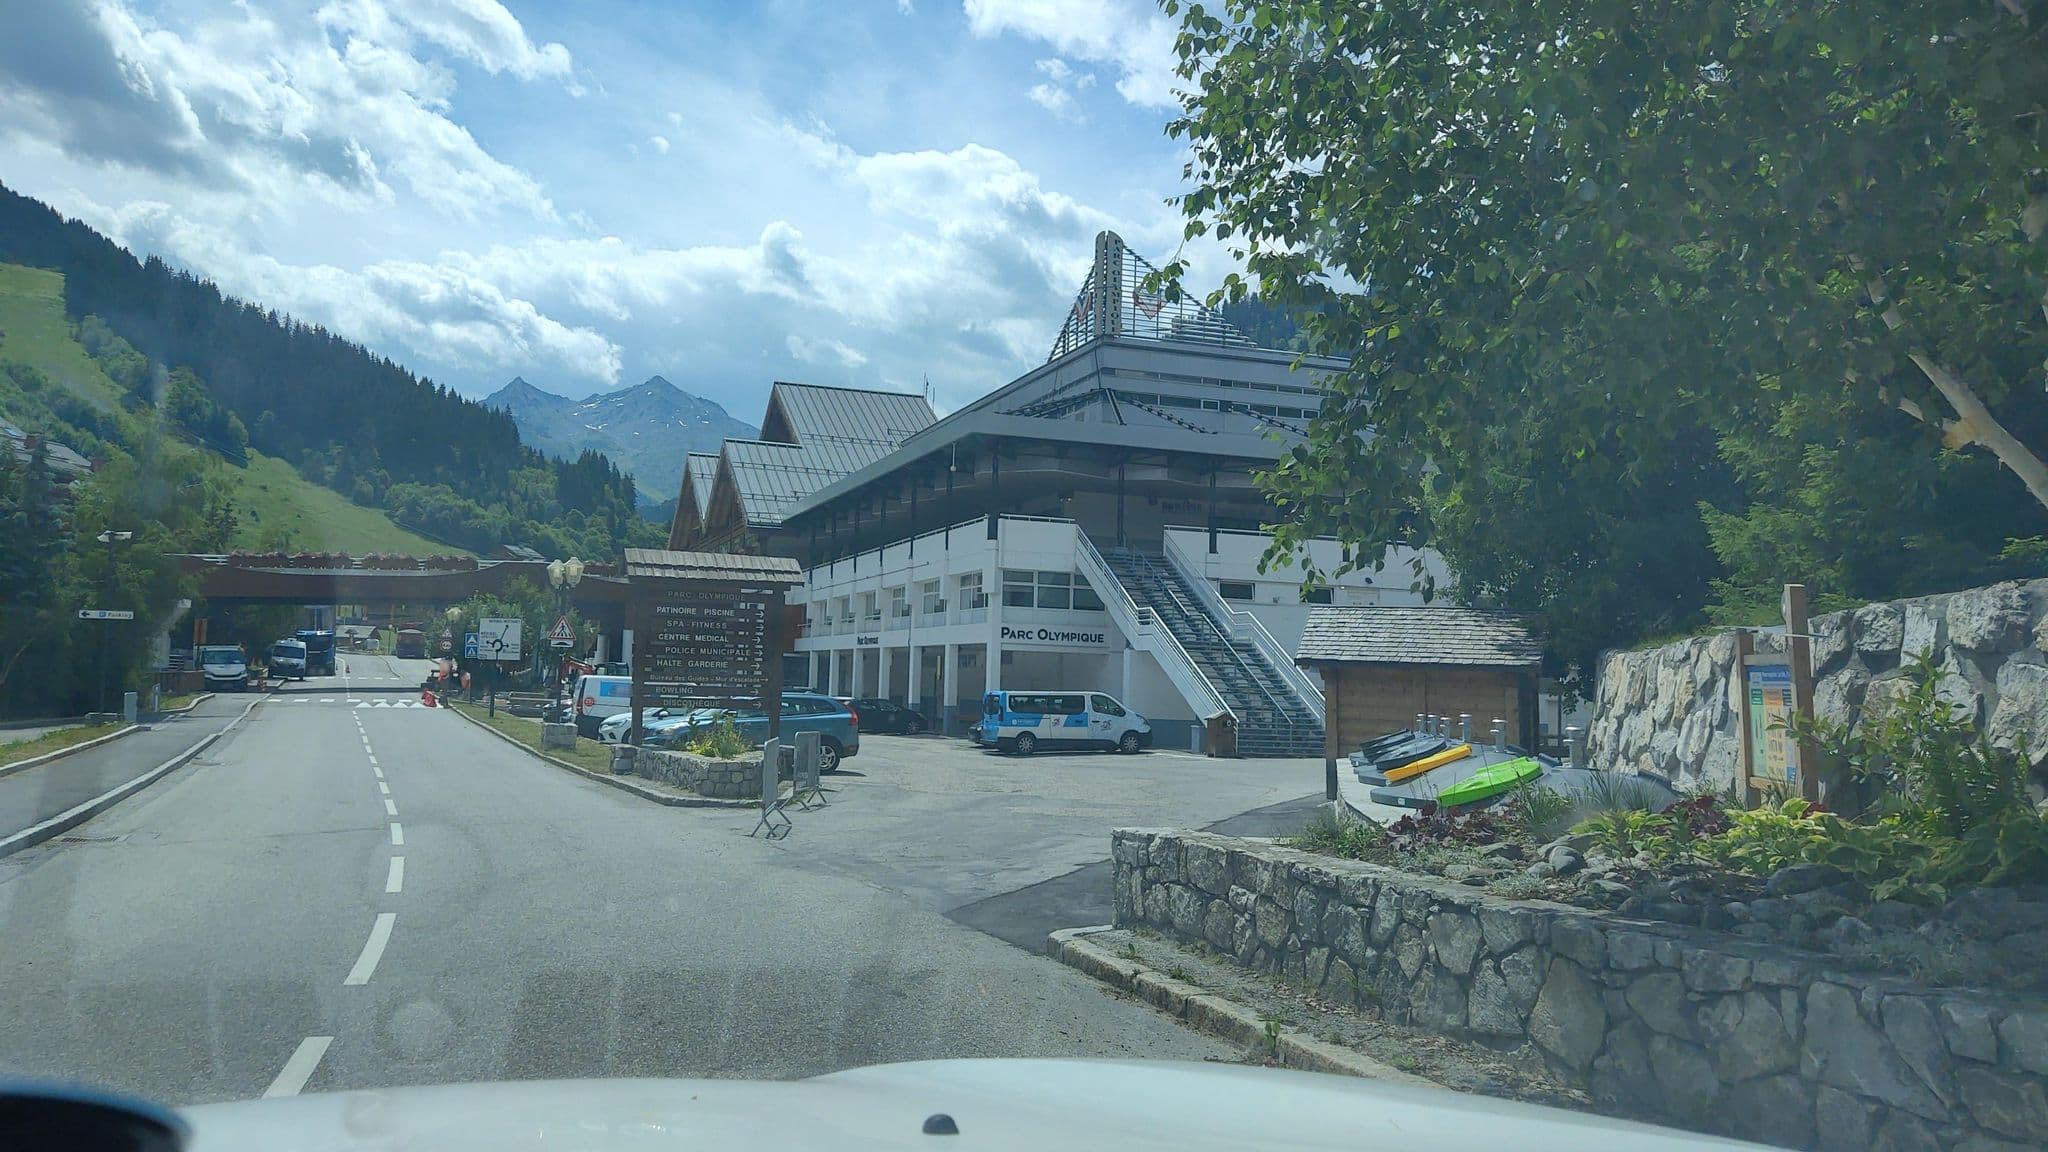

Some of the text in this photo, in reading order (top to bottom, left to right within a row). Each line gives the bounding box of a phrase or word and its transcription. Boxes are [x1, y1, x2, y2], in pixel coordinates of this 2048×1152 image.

[668, 591, 746, 601] PARC OLYMPIQUE
[656, 606, 735, 617] PATINOIRE PISCINE
[691, 621, 727, 629] FITNESS
[658, 633, 729, 642] CENTRE MEDICAL
[1001, 626, 1105, 643] PARC OLYMPIQUE
[665, 646, 751, 656] POLICE MUNICIPALE
[656, 659, 729, 668] HALTE GARDERIE
[655, 686, 694, 694] BOWLING
[663, 699, 721, 707] DISCOTHEQUE
